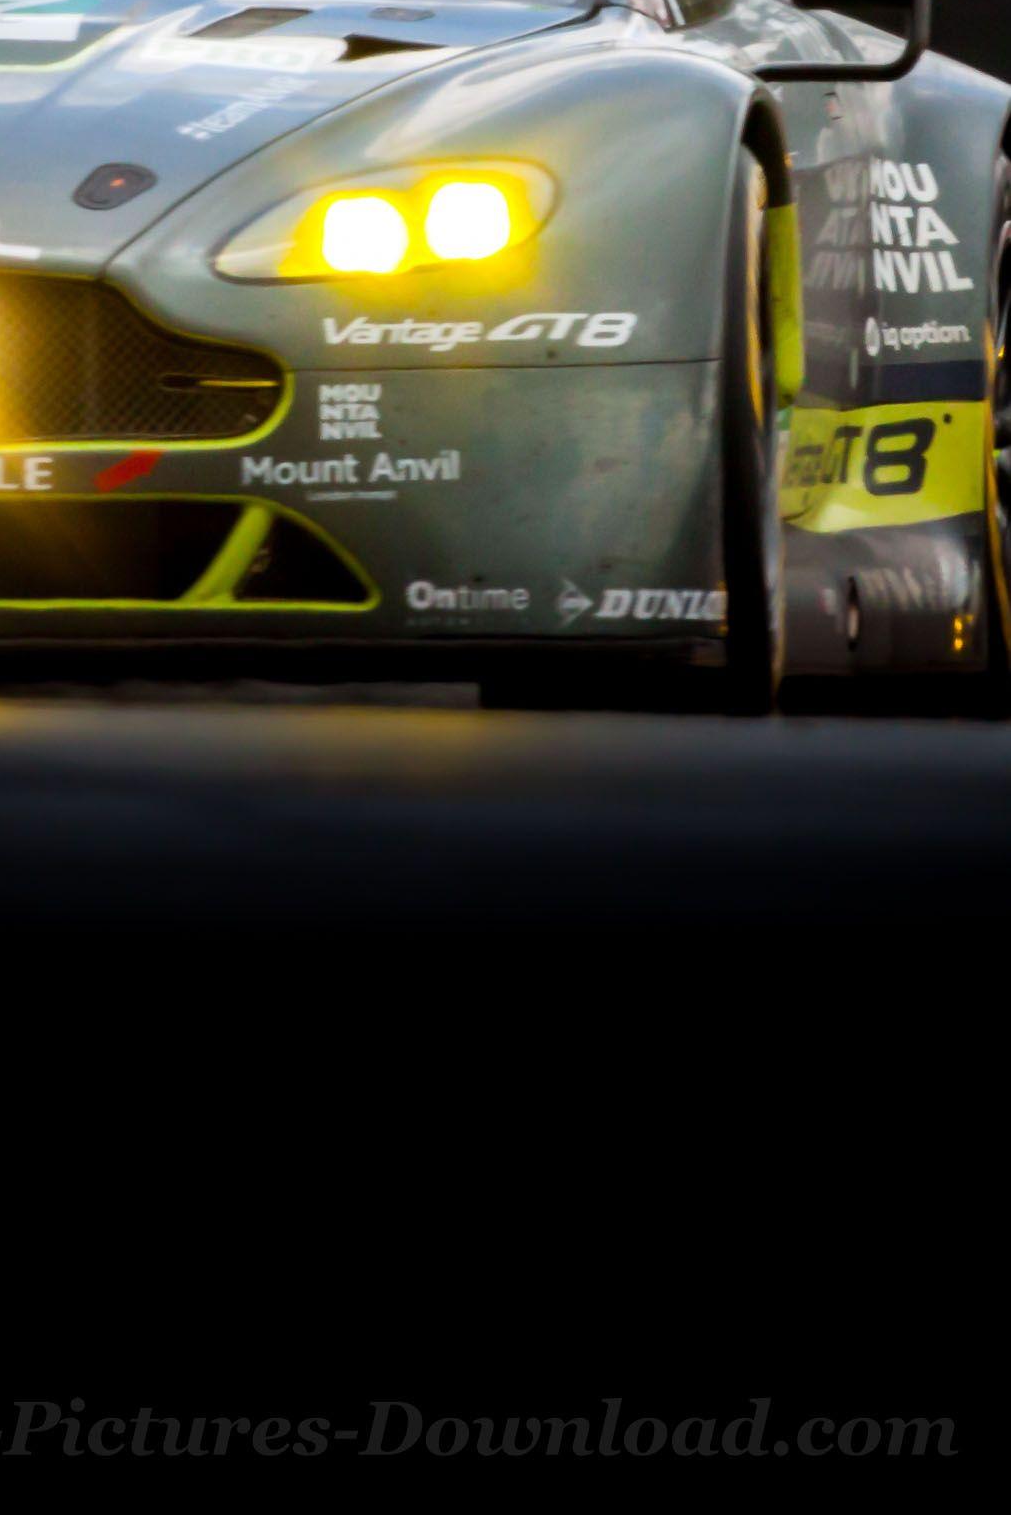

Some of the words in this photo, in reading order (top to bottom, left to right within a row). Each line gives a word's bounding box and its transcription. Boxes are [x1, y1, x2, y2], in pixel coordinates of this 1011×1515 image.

[870, 201, 961, 247] NTA
[873, 249, 975, 294] NVIL
[323, 316, 484, 352] Vantage
[487, 312, 638, 348] GT8
[900, 320, 973, 351] option
[242, 452, 360, 485] Mount
[368, 450, 461, 483] Anvil
[405, 580, 530, 611] Ontime
